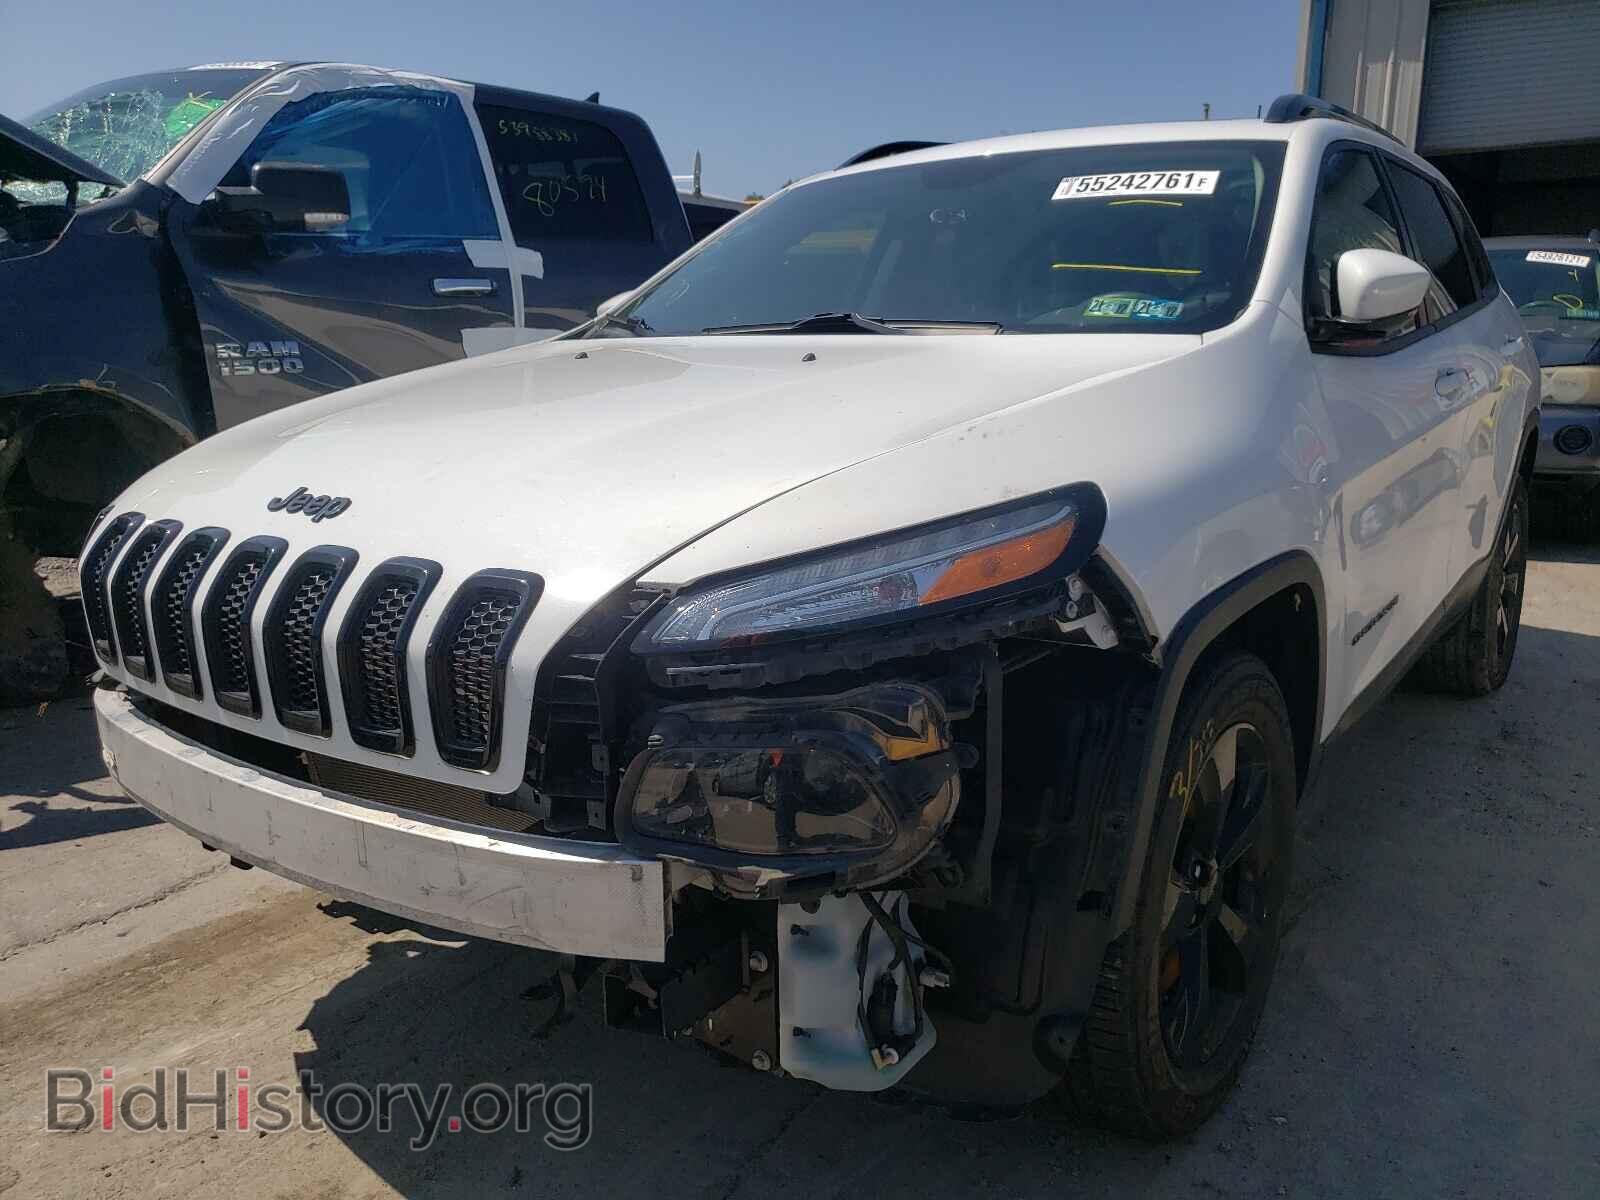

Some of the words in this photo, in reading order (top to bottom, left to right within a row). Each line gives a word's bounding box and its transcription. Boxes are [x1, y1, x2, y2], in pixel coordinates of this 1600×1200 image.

[1076, 172, 1194, 193] 55242761
[1198, 177, 1208, 188] F
[215, 340, 301, 358] RAM
[219, 358, 305, 376] 1500
[267, 486, 352, 523] Jeep
